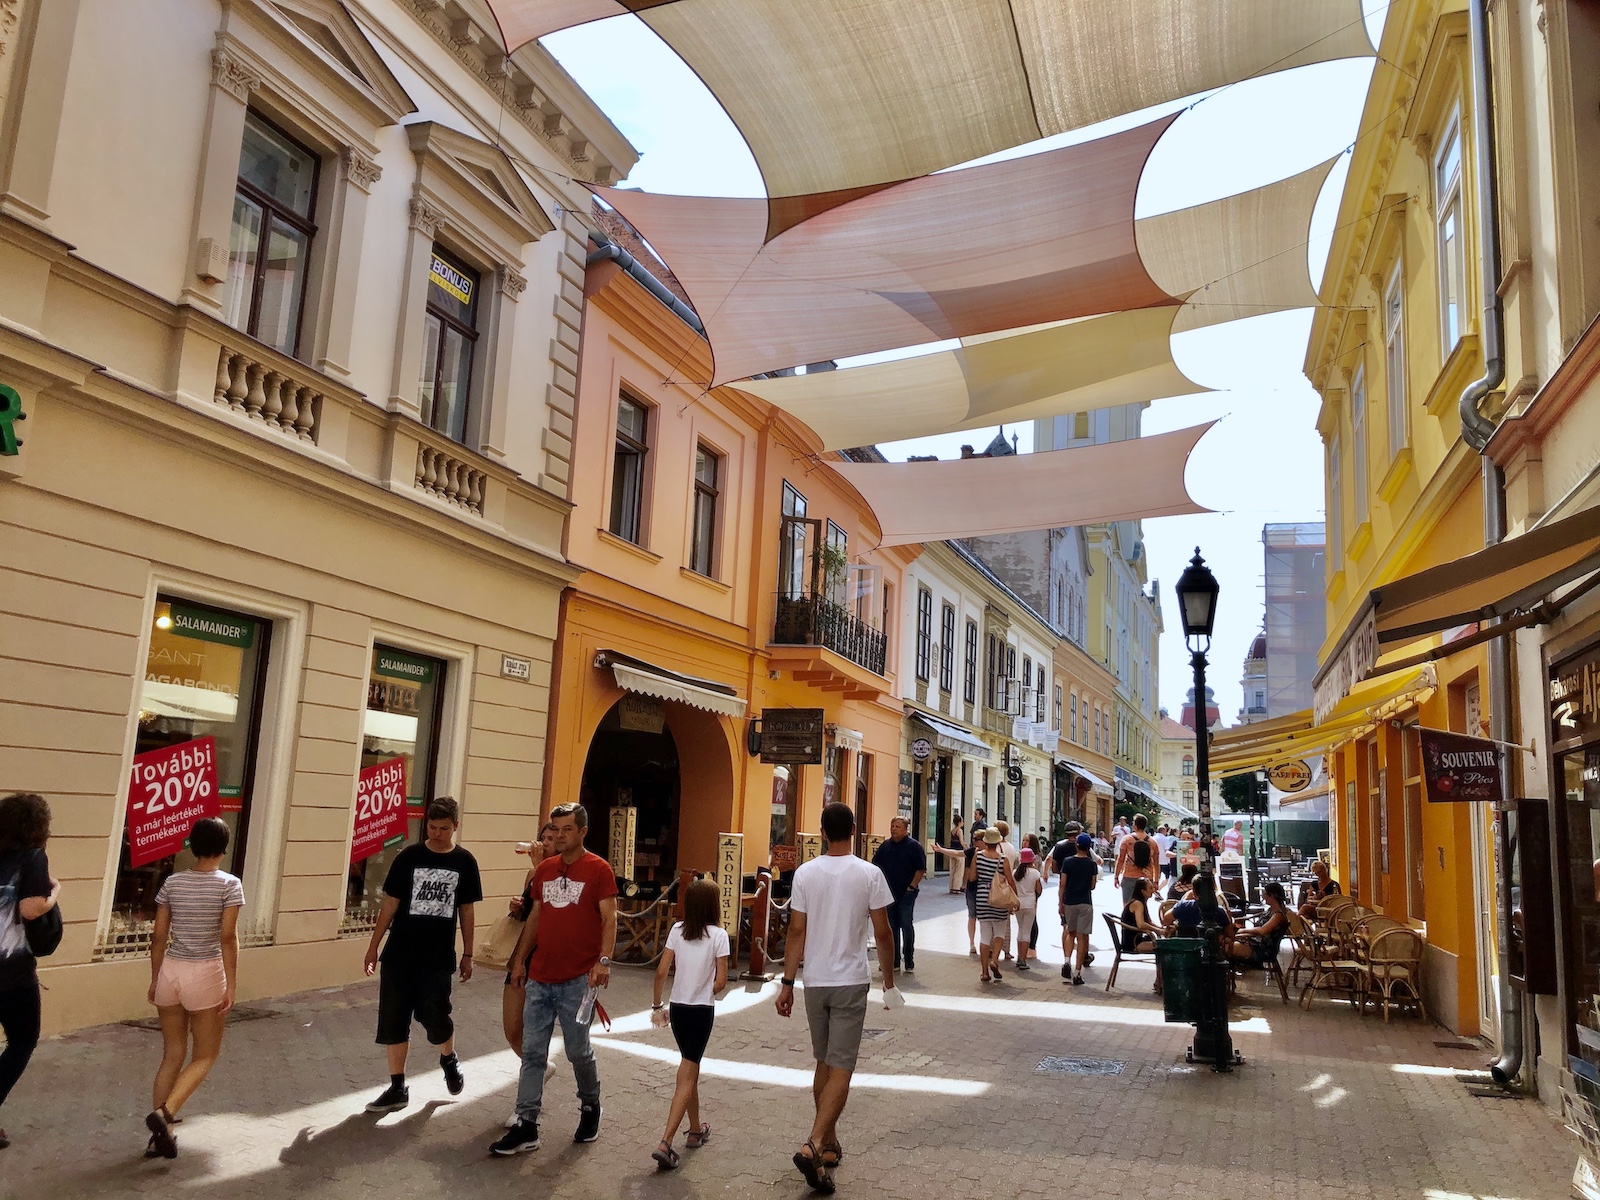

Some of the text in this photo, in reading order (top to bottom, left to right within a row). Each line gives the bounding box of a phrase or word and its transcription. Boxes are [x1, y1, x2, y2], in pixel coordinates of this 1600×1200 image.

[433, 259, 470, 293] BONUS
[175, 614, 241, 638] SALAMANDER
[380, 658, 424, 676] SALAMANDER
[145, 672, 232, 693] AGABOND
[132, 743, 212, 784] További
[1441, 751, 1496, 768] SOUVENIR
[358, 763, 402, 793] ovábbi
[132, 767, 212, 815] -20%
[135, 804, 204, 835] a már leértékelt
[357, 823, 369, 835] már
[136, 820, 190, 847] termékekre!
[421, 880, 450, 892] MAKE
